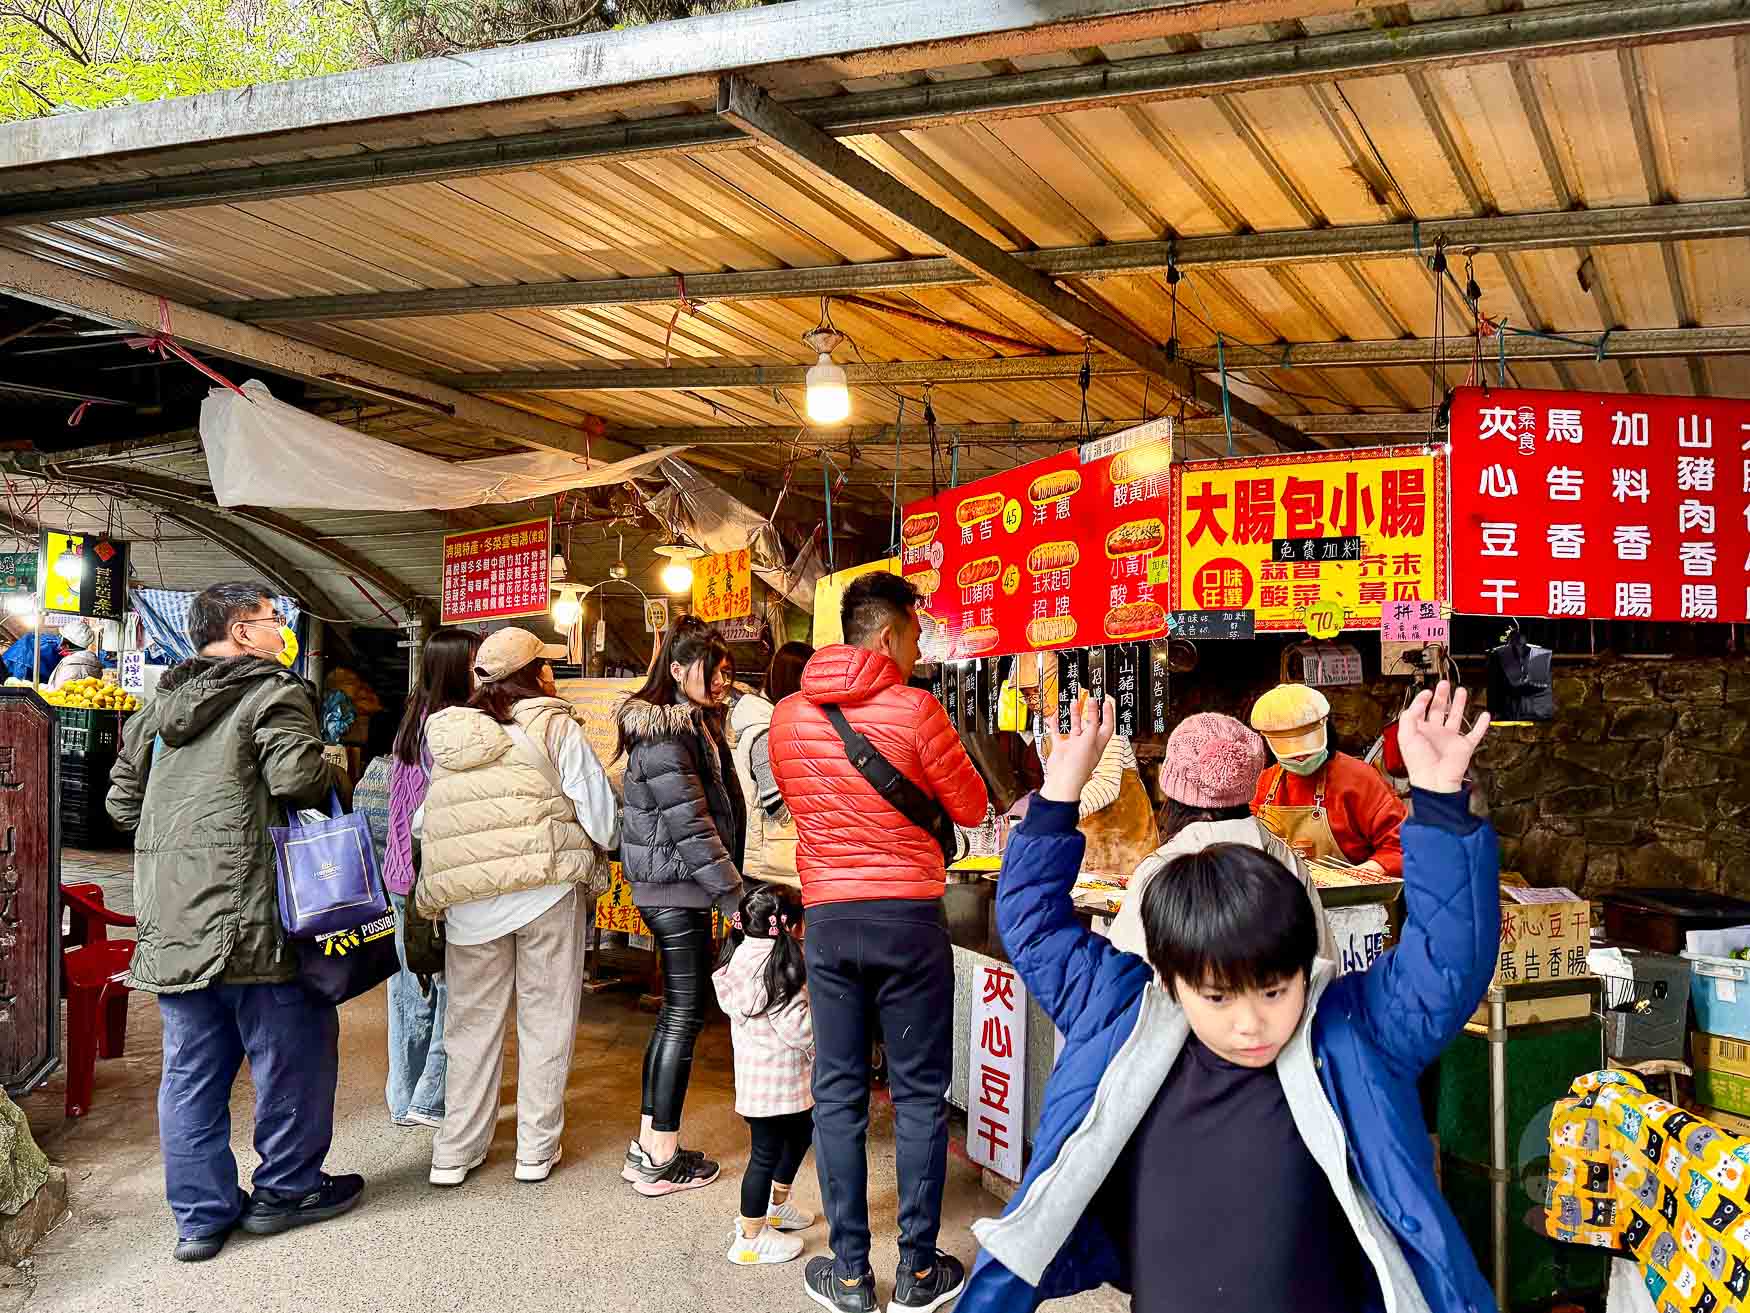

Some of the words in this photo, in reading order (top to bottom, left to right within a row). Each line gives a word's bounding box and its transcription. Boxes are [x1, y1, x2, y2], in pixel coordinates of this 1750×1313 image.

[1518, 405, 1536, 456] (素食)
[1113, 480, 1160, 507] 酸黃瓜
[1005, 509, 1017, 524] 45
[1186, 468, 1426, 549] 大腸包小腸
[1478, 406, 1520, 614] 夾心豆干
[1546, 408, 1586, 616] 馬告香腸
[1611, 411, 1652, 618] 加料香腸
[1677, 414, 1718, 619] 山豬肉香腸
[961, 519, 993, 545] 馬告
[1280, 540, 1360, 560] 免費加料
[1004, 570, 1016, 589] 45
[1032, 569, 1071, 595] 玉米起司
[1203, 569, 1243, 588] 口味
[961, 583, 994, 606] 山豬肉
[1032, 597, 1070, 618] 招牌
[1110, 584, 1155, 608] 酸菜
[1203, 588, 1243, 608] 任選
[962, 608, 993, 628] 蒜味
[1311, 611, 1333, 633] 70
[1427, 626, 1444, 637] 110
[1118, 658, 1134, 736] 山豬肉香腸
[1153, 660, 1165, 733] 馬告香腸
[1500, 945, 1587, 980] 馬告香腸
[977, 966, 1015, 1161] 夾心豆干
